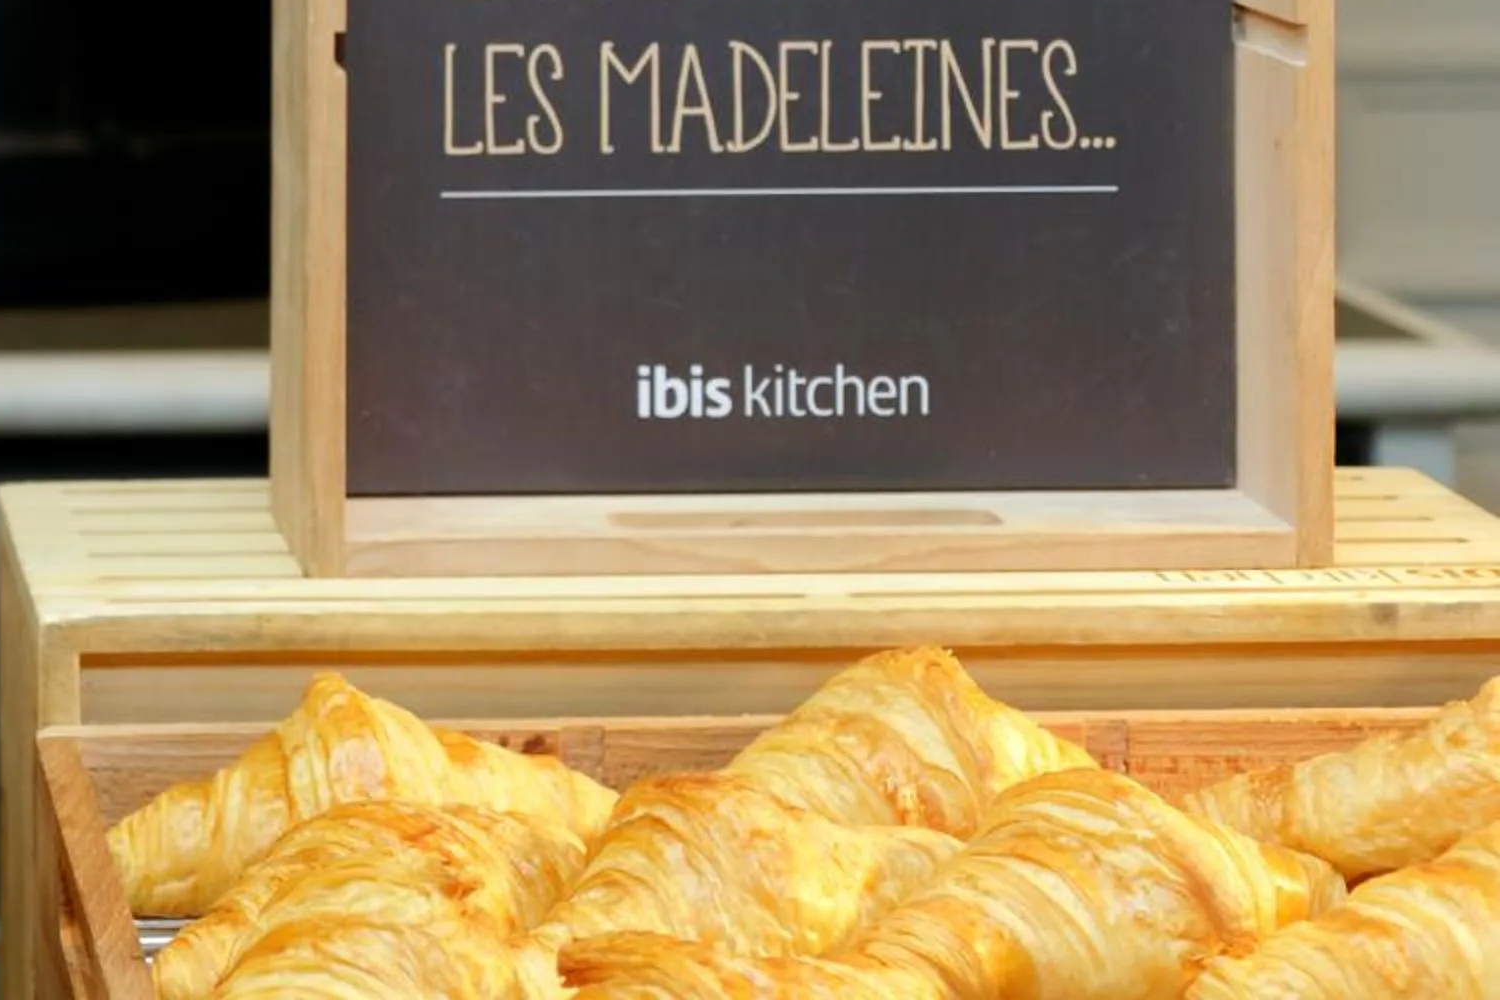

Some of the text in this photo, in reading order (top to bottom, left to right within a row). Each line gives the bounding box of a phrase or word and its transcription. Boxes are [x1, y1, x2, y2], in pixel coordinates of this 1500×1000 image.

[443, 37, 1117, 156] LES MADELEINES...
[636, 362, 930, 419] ibis kitchen
